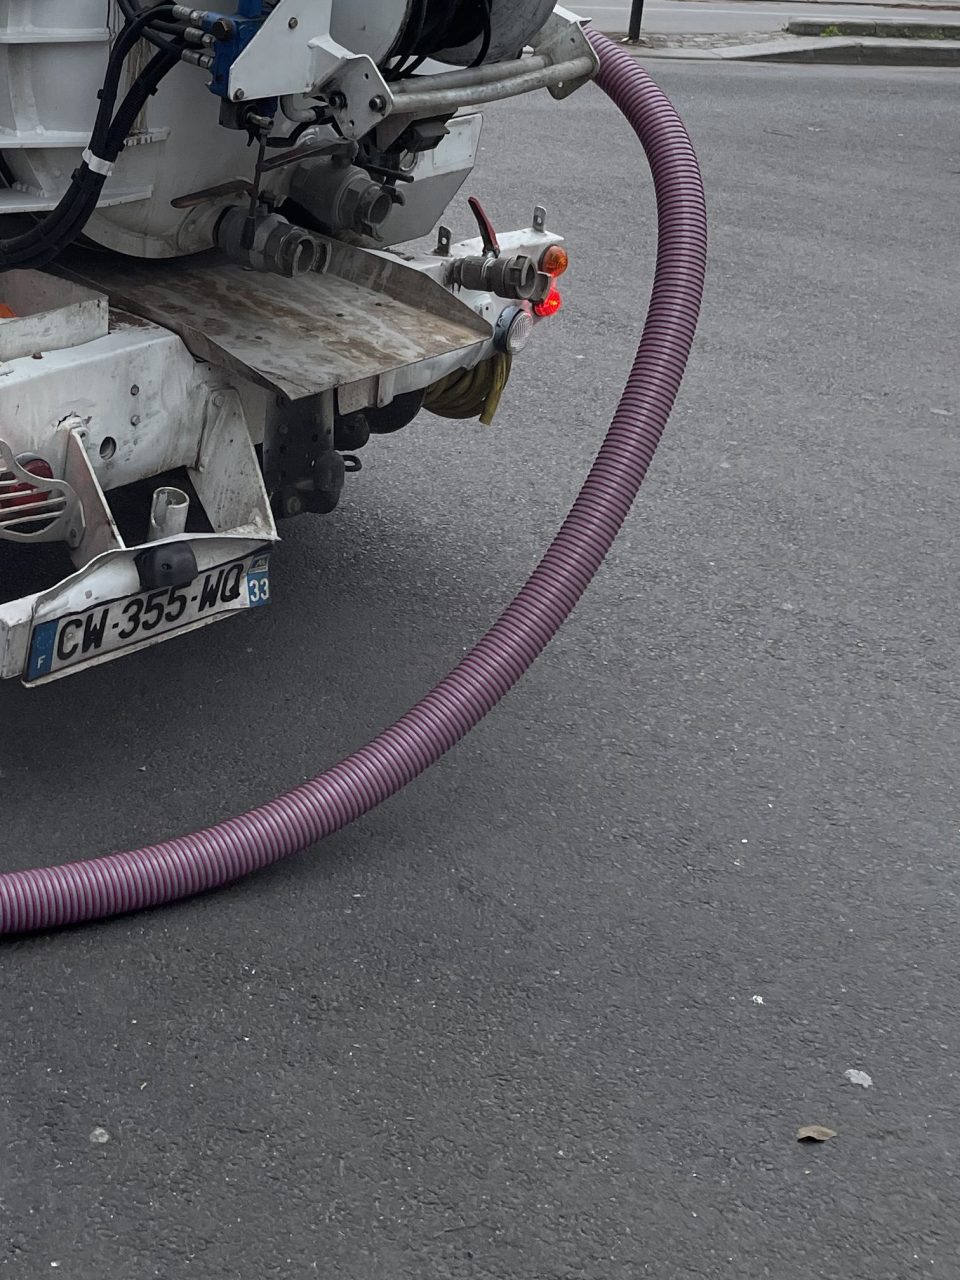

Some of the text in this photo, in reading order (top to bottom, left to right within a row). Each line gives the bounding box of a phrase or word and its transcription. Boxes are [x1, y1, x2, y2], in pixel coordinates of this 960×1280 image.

[249, 578, 270, 602] 33
[56, 563, 245, 661] CW-355-WQ
[36, 655, 46, 669] F
